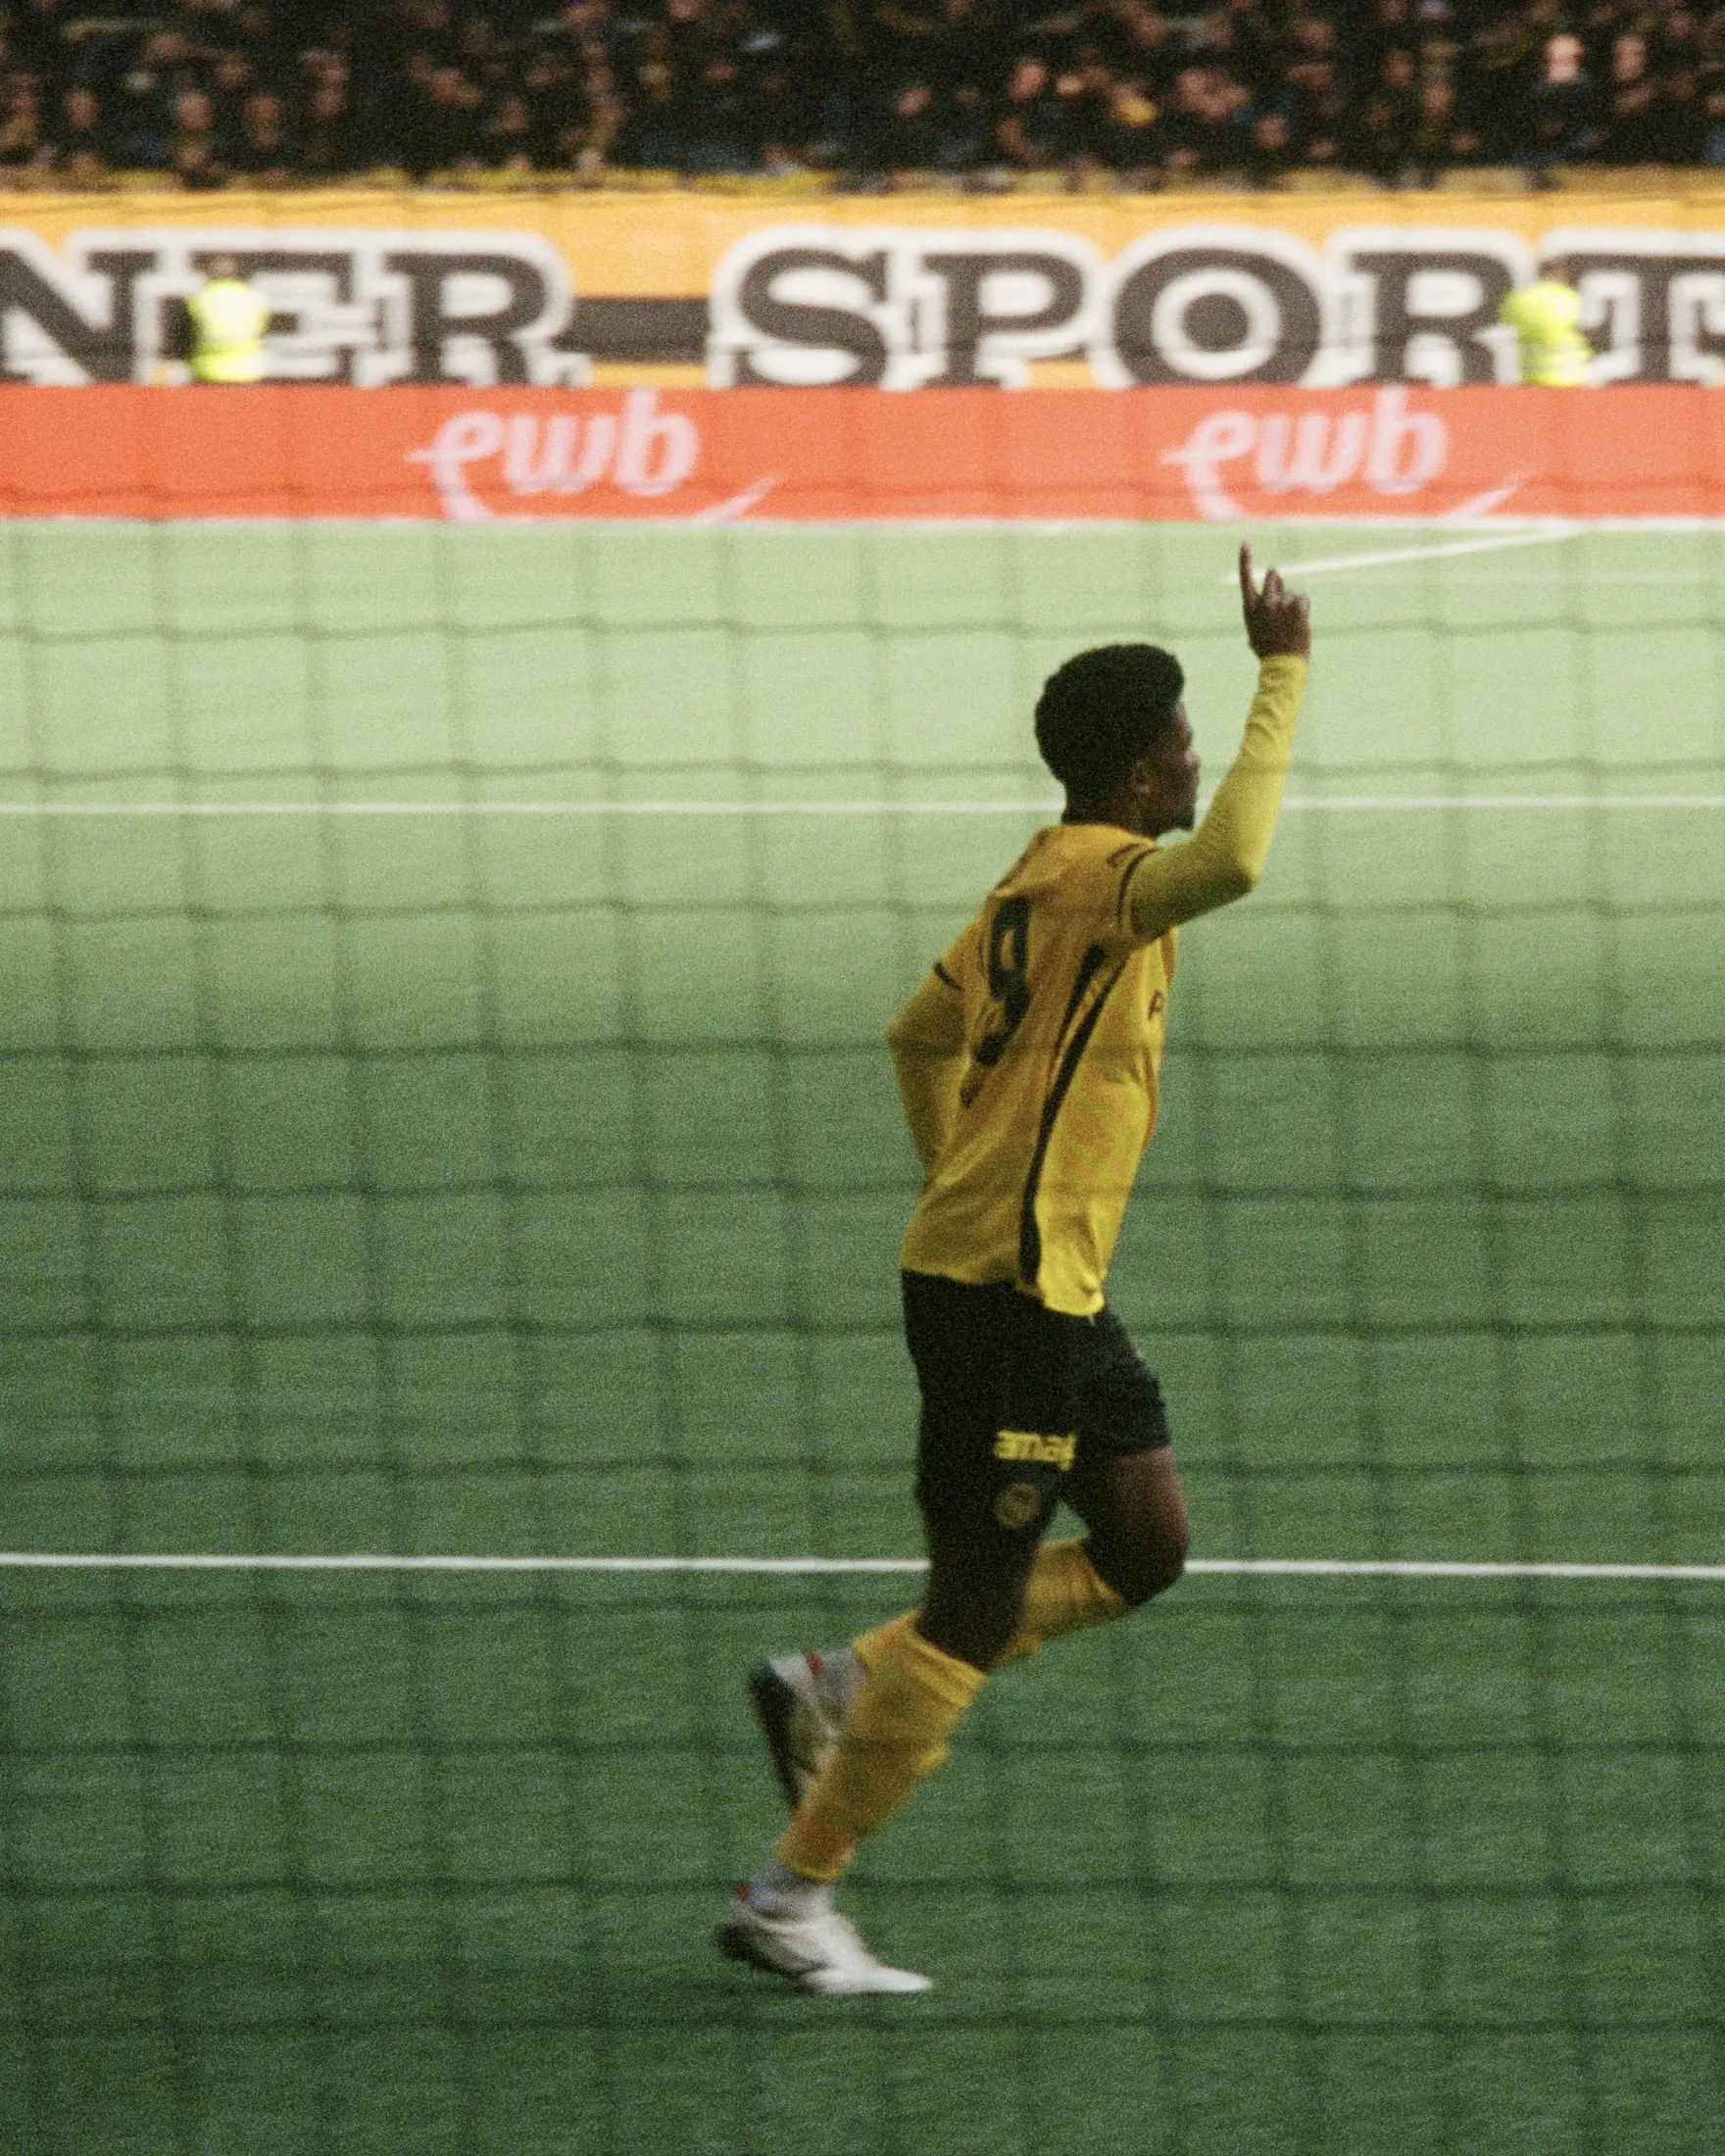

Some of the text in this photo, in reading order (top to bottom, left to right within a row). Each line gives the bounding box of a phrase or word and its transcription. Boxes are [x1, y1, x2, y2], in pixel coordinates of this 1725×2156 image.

[730, 241, 1725, 384] SPORT
[405, 388, 702, 521] ewb
[1161, 385, 1449, 520] ewb
[974, 896, 1031, 1066] 9
